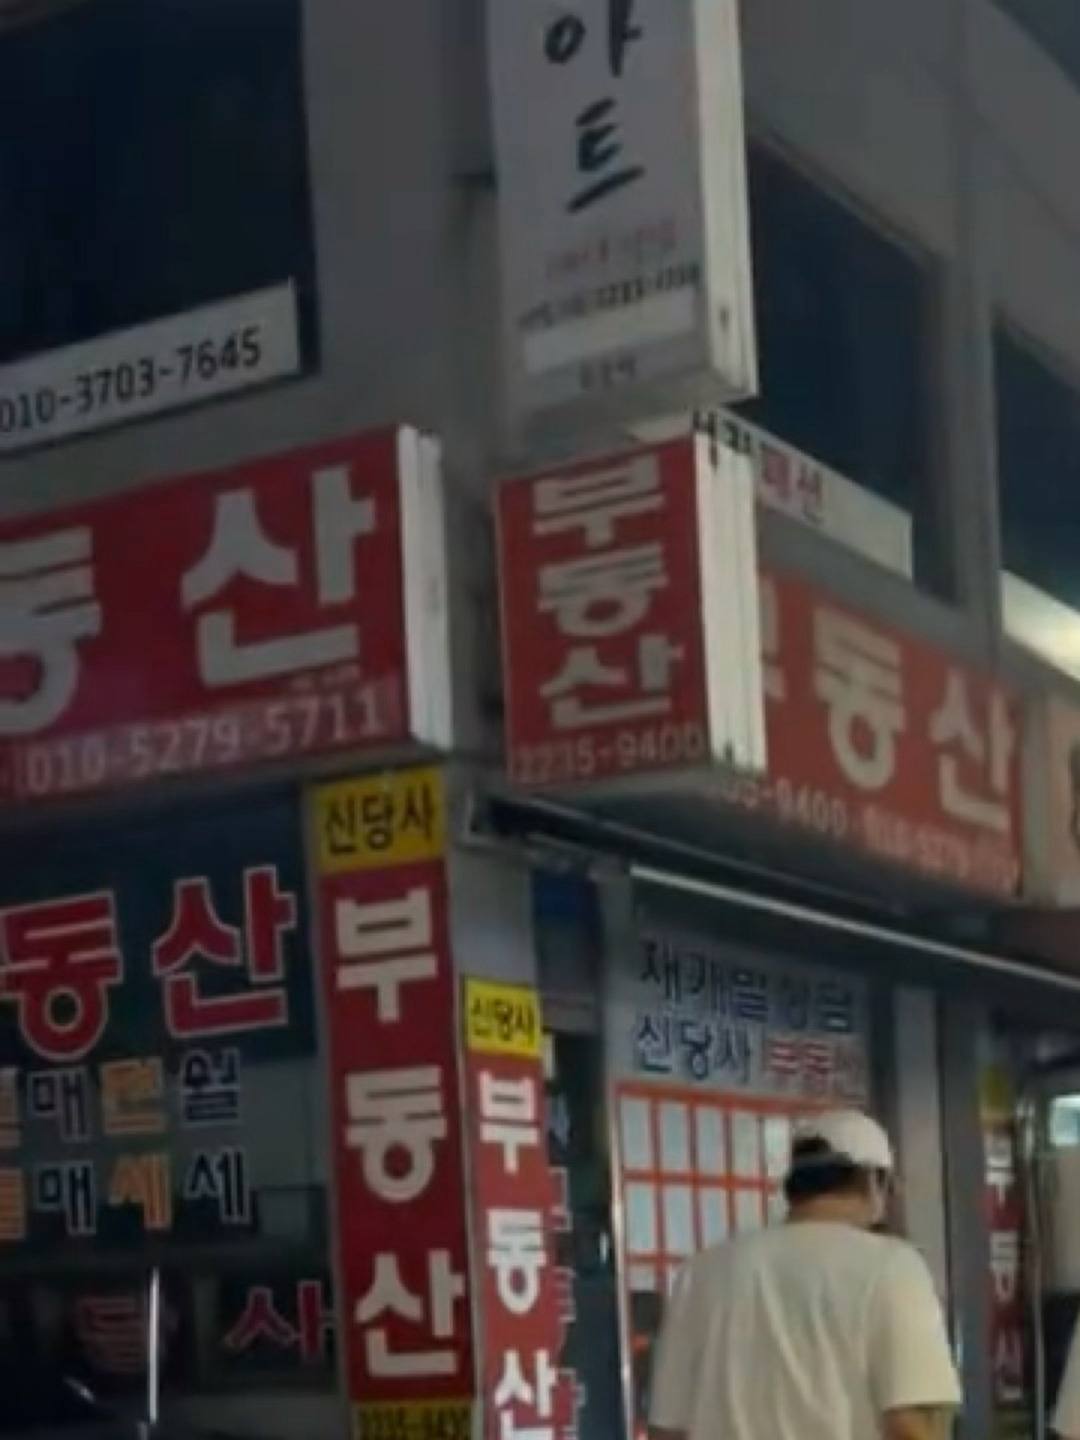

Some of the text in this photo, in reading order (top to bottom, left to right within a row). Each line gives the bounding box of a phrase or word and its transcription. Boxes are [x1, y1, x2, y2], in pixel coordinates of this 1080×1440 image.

[532, 453, 685, 731] 부동산
[762, 576, 1014, 832] 동산
[322, 786, 440, 858] 신당사
[333, 889, 467, 1380] 부동산
[470, 992, 537, 1046] 신당사
